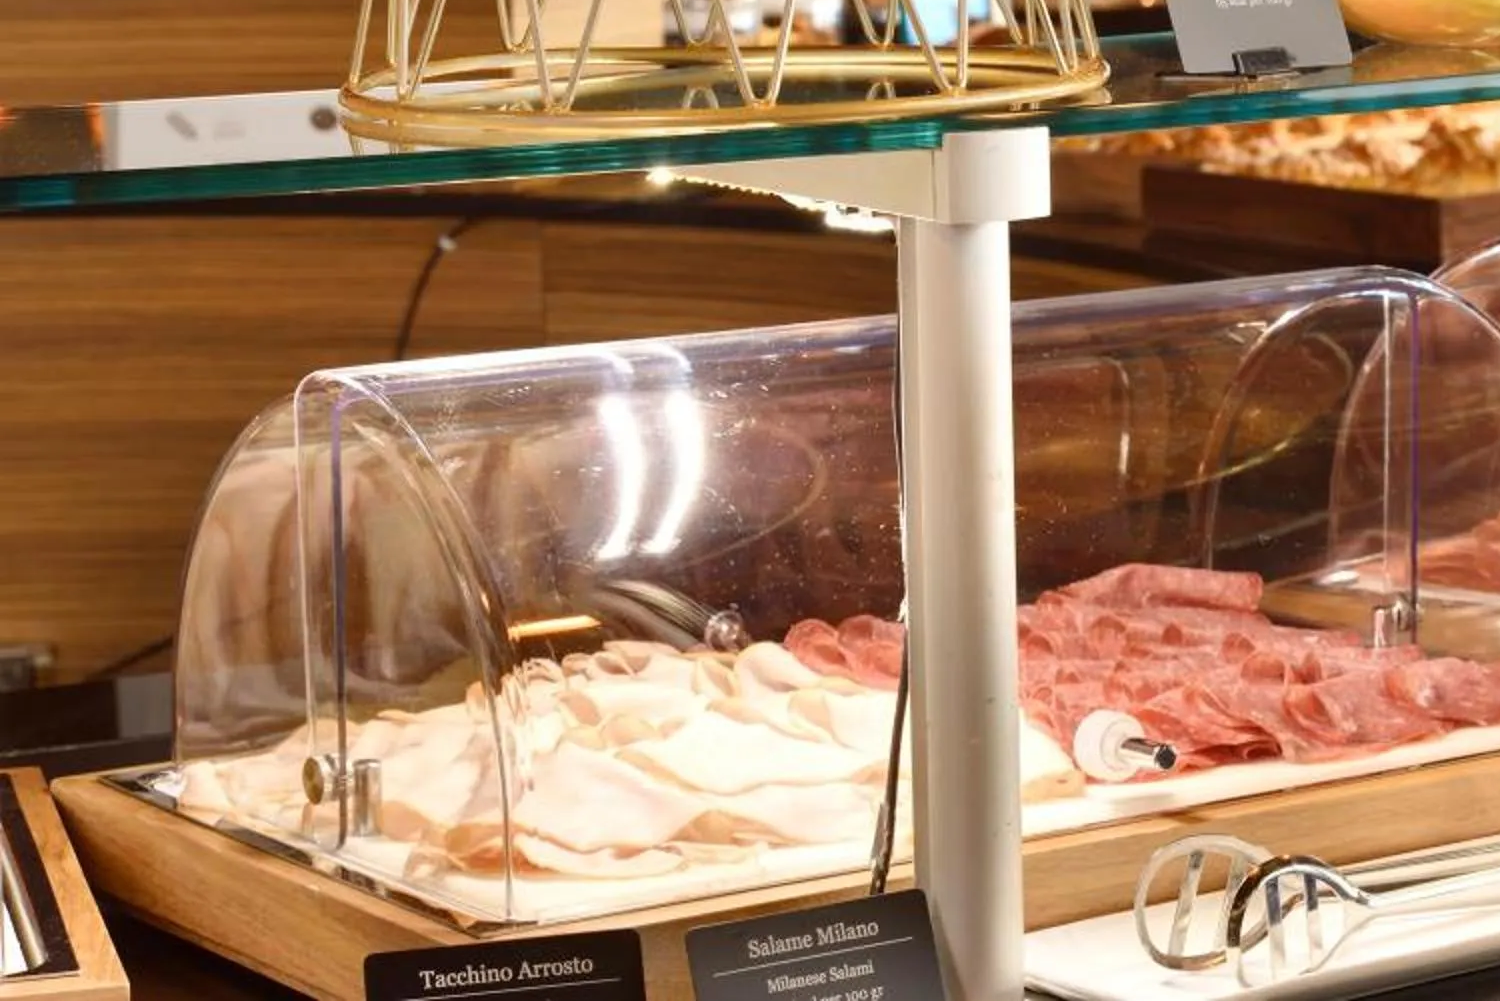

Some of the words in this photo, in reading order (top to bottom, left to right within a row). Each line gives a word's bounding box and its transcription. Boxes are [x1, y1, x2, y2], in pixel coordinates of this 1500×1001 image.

[747, 934, 813, 959] Salame
[815, 921, 879, 946] Milano
[419, 963, 514, 990] Tacchino
[517, 956, 594, 981] Arrosto
[766, 974, 827, 994] Milanese
[828, 959, 875, 982] Salami
